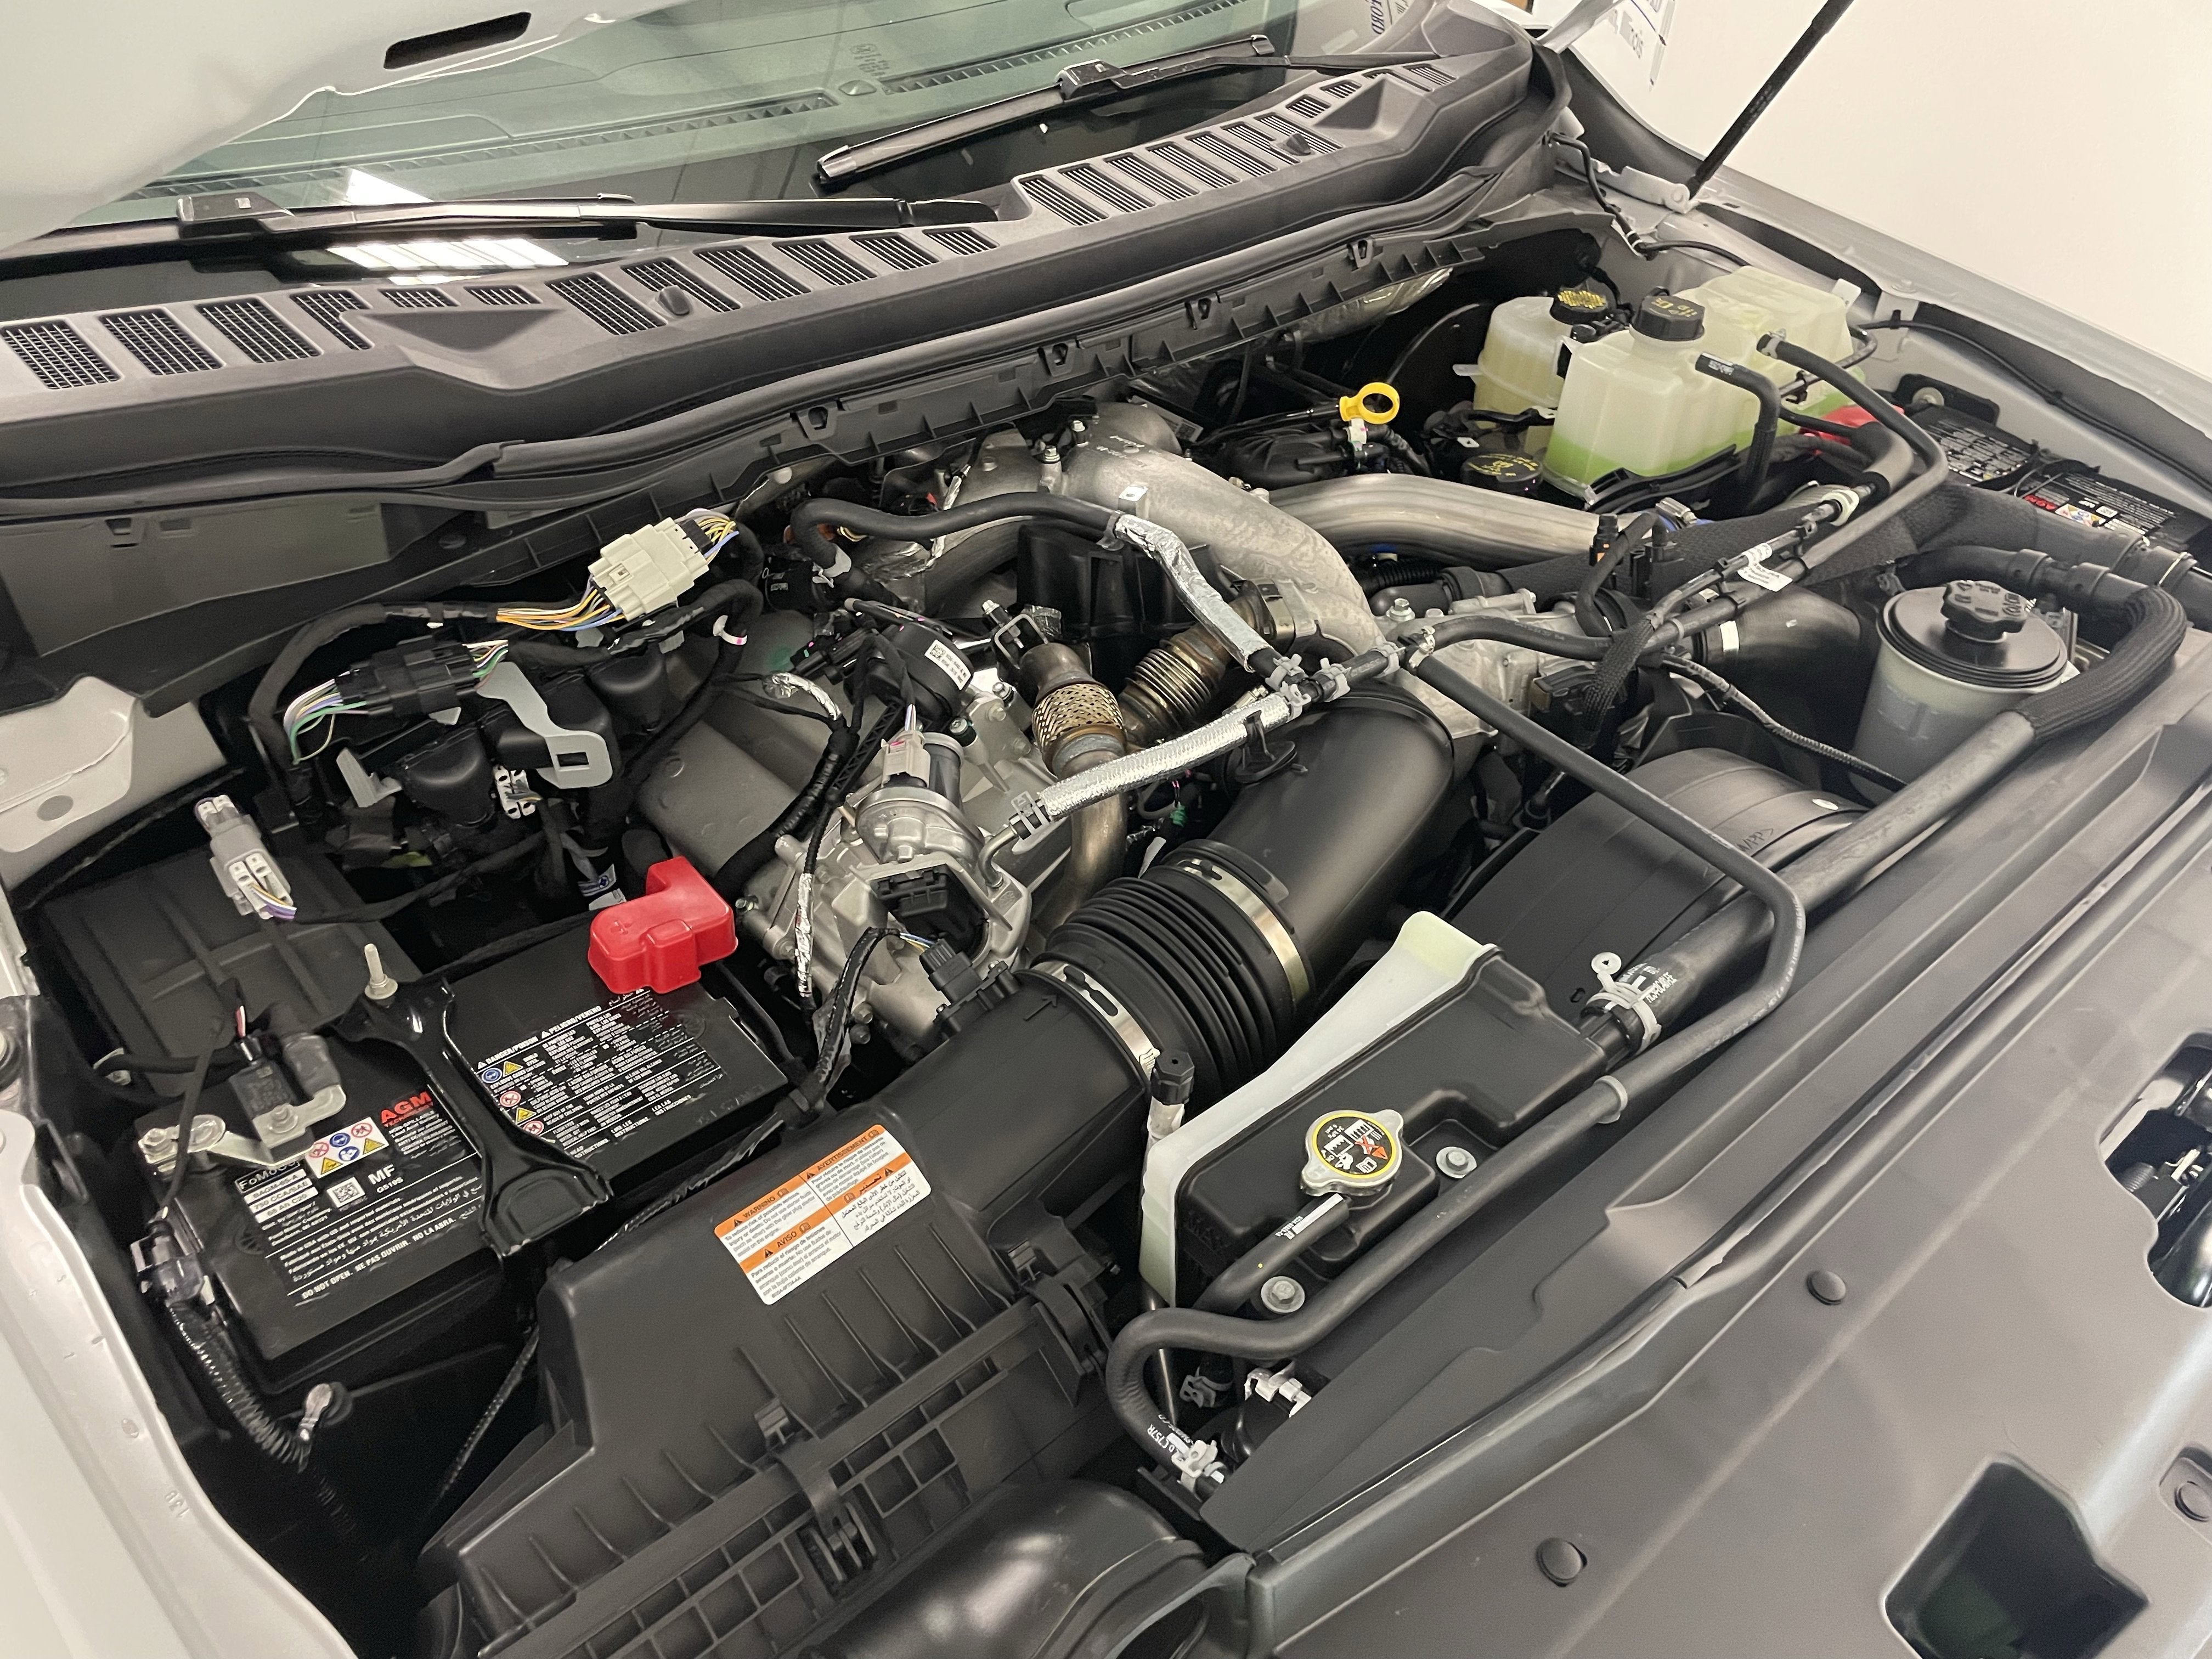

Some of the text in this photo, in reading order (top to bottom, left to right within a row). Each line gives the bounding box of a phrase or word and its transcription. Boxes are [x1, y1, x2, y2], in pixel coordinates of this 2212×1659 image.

[549, 1006, 601, 1033] PELIGRO/VENENO
[486, 1037, 538, 1063] DANGER/POISON
[382, 1093, 430, 1122] AGM
[817, 1137, 867, 1170] AVERTISSEMENT
[369, 1165, 394, 1184] MF
[743, 1197, 775, 1217] WARNING
[777, 1231, 797, 1248] AVISO
[302, 1218, 455, 1299] DO NOT OPEN. NE PAS OUVRIR. NO LA ABRA.
